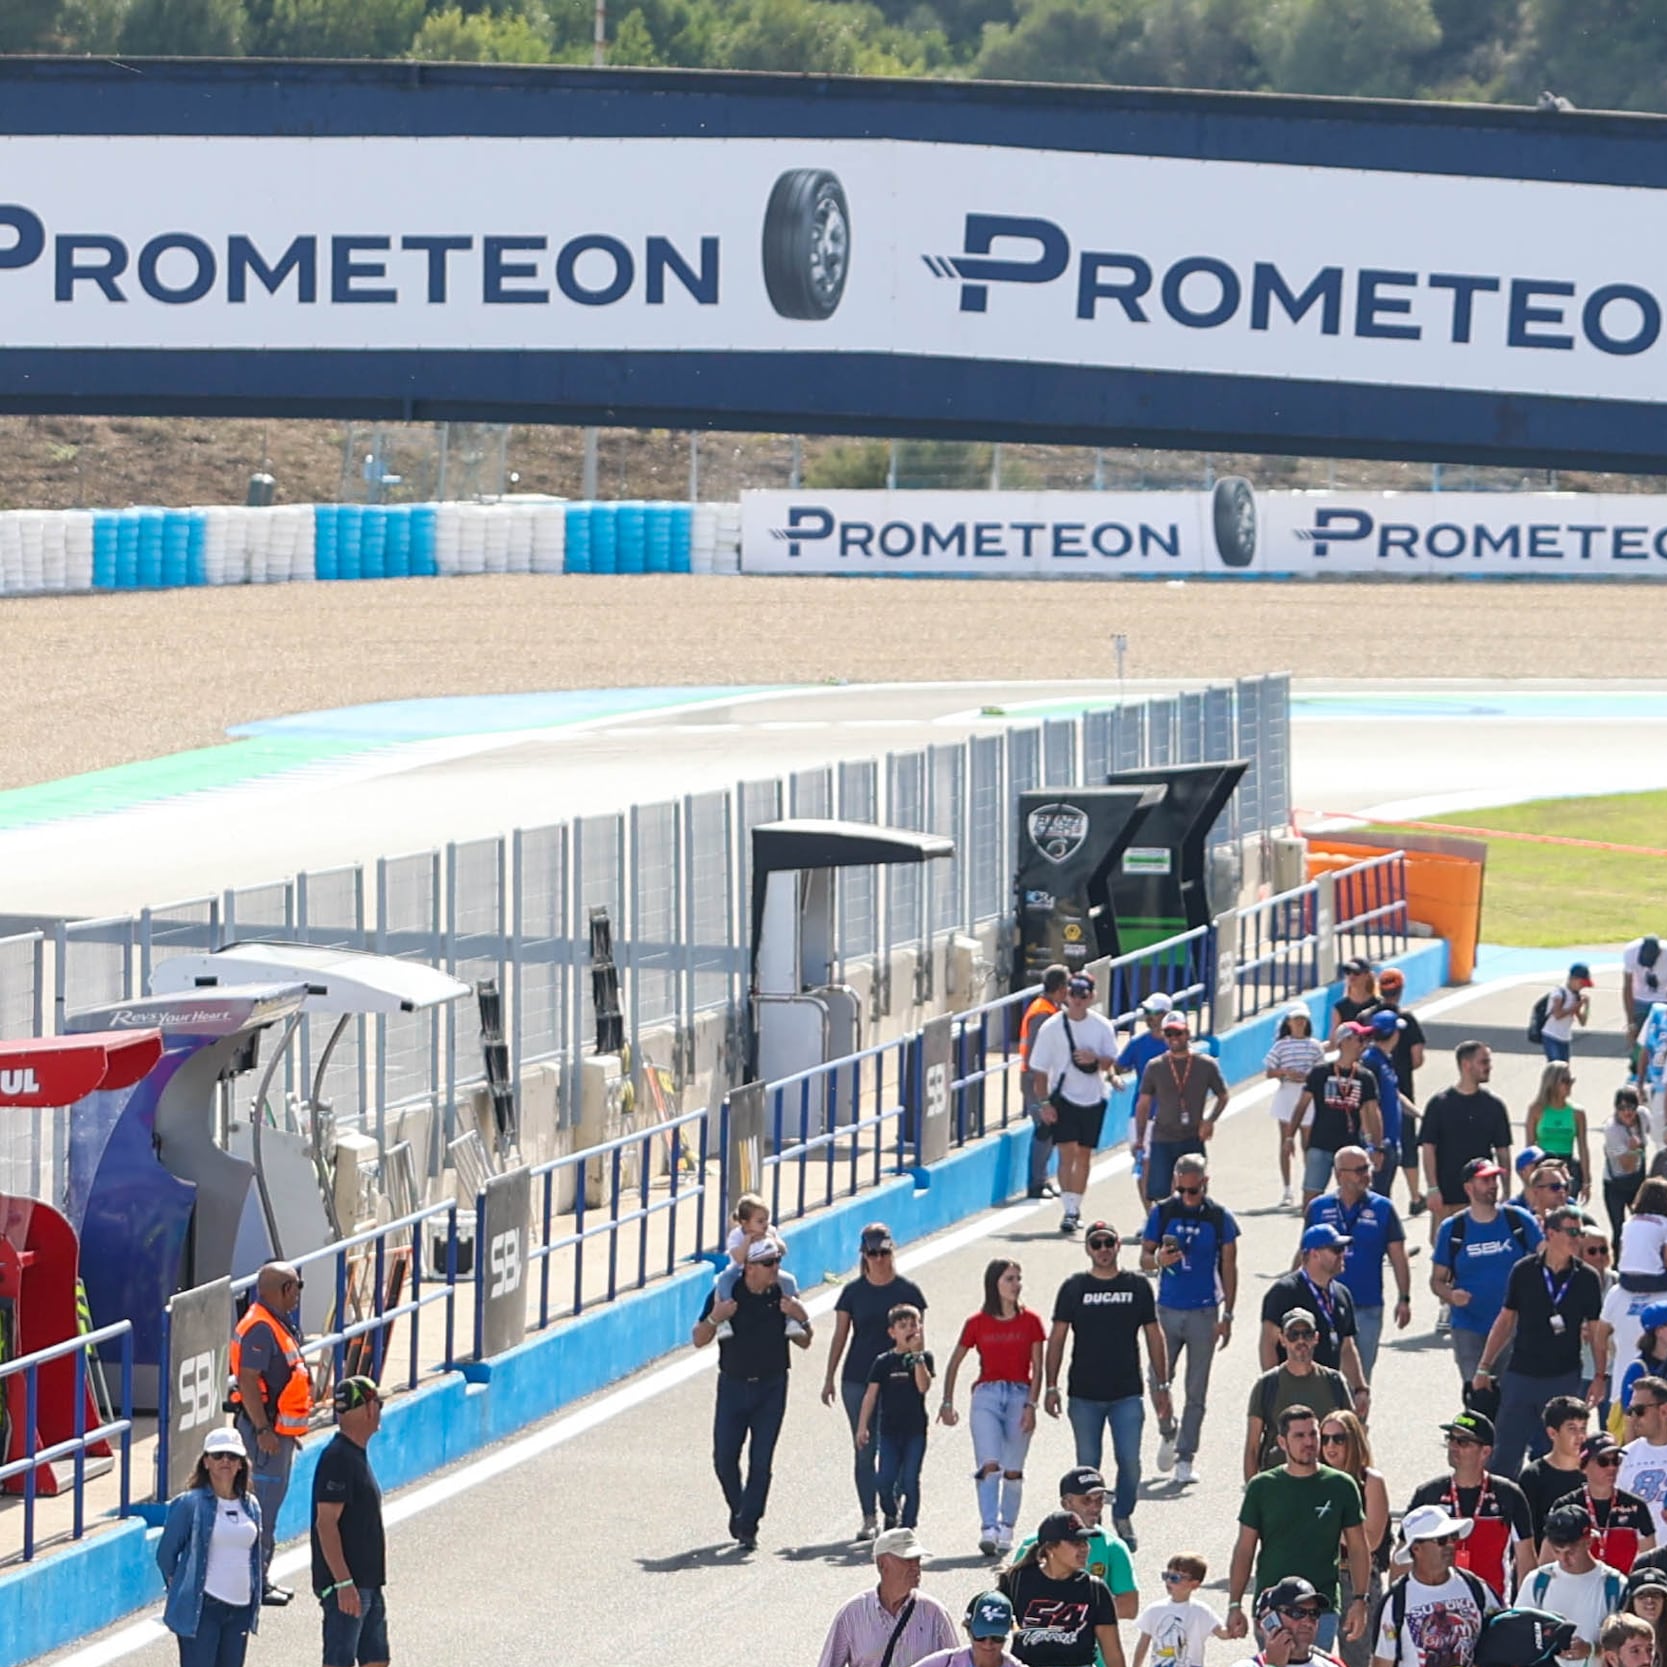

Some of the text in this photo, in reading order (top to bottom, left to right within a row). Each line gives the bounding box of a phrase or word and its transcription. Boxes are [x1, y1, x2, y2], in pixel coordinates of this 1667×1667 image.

[774, 506, 1181, 558] PROMETEON
[1466, 1237, 1513, 1258] SBK
[1082, 1292, 1134, 1305] DUCATI
[1022, 1598, 1088, 1630] 54
[1411, 1600, 1477, 1618] SUUKA
